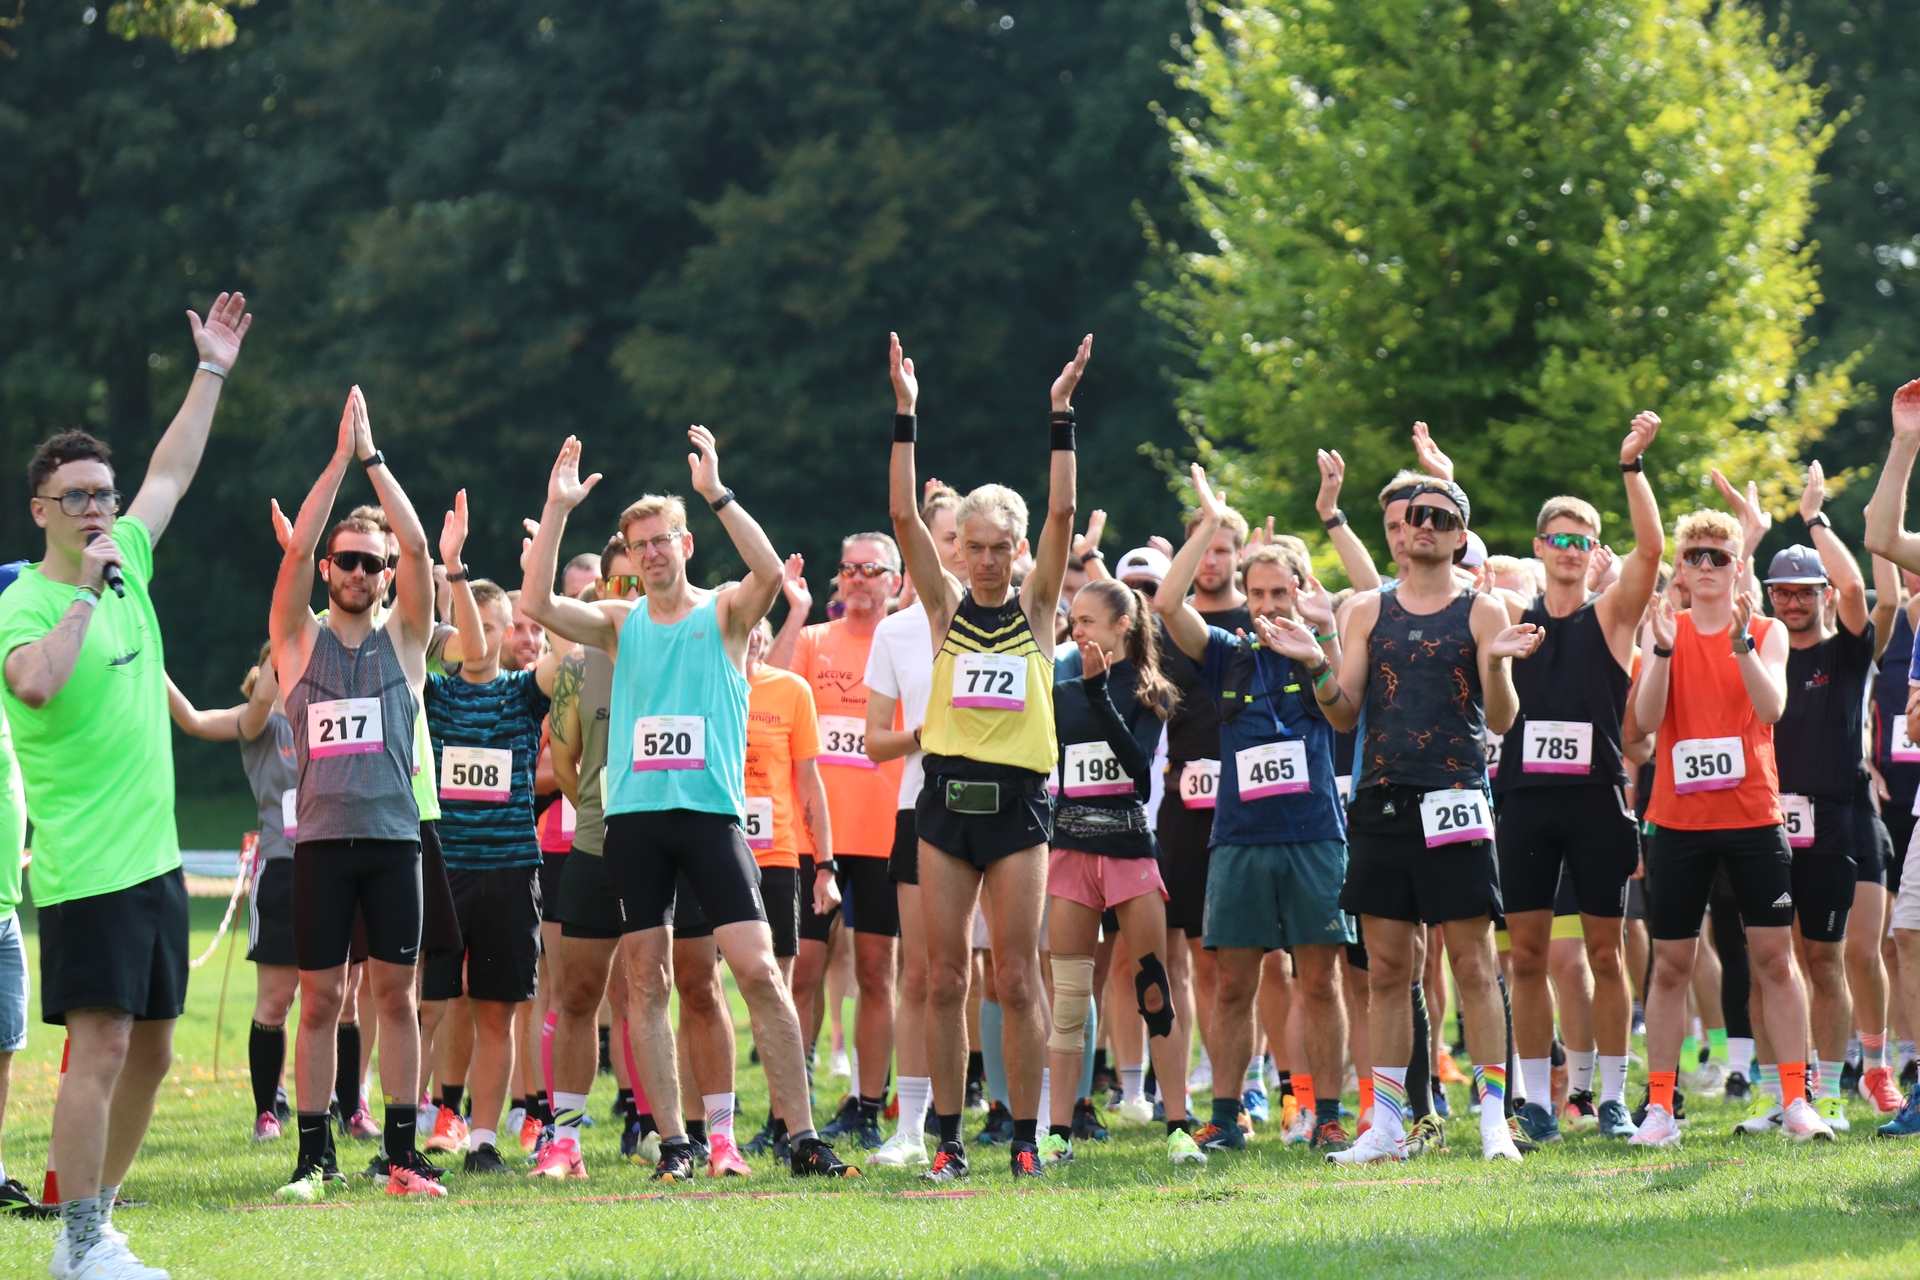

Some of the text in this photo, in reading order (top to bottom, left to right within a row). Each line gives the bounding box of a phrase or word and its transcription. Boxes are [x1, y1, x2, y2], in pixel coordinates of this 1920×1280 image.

[966, 670, 1014, 695] 772
[319, 715, 367, 743] 217
[644, 731, 691, 756] 520
[826, 730, 866, 755] 338
[1535, 736, 1578, 760] 785
[452, 762, 499, 787] 508
[1075, 757, 1120, 783] 198
[1249, 758, 1295, 784] 465
[1684, 752, 1732, 779] 350
[1189, 773, 1220, 796] 30
[1435, 802, 1483, 831] 261
[1782, 811, 1801, 834] 5
[1827, 910, 1836, 932] FUSION
